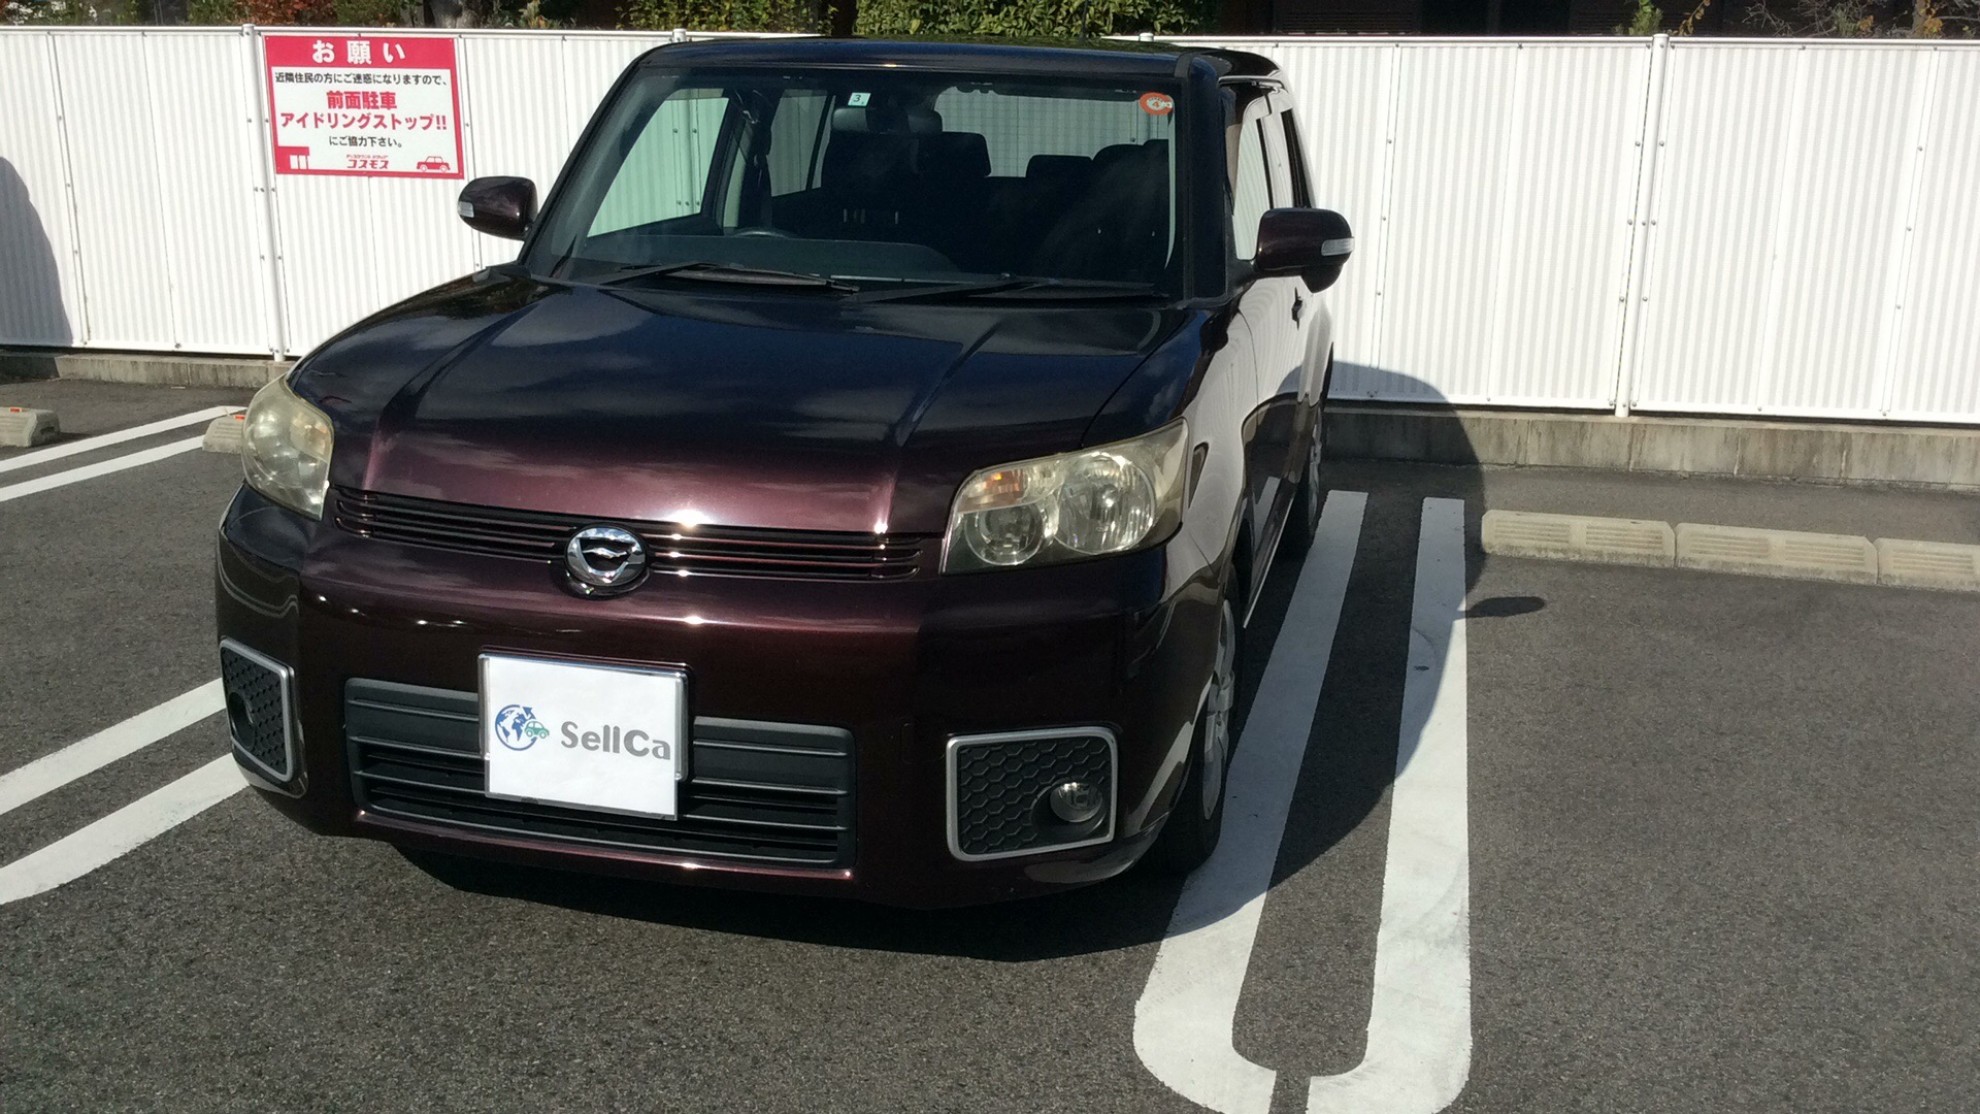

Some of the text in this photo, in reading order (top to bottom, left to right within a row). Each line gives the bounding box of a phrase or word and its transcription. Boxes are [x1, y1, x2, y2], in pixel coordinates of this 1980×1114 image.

[312, 39, 406, 65] お願い
[275, 72, 447, 86] 近隣住民の方にご迷惑になりますので、
[326, 90, 398, 110] 前面駐車
[329, 136, 402, 148] にご協力下さい。
[346, 159, 389, 169] コスモス
[561, 721, 671, 760] SellCa
